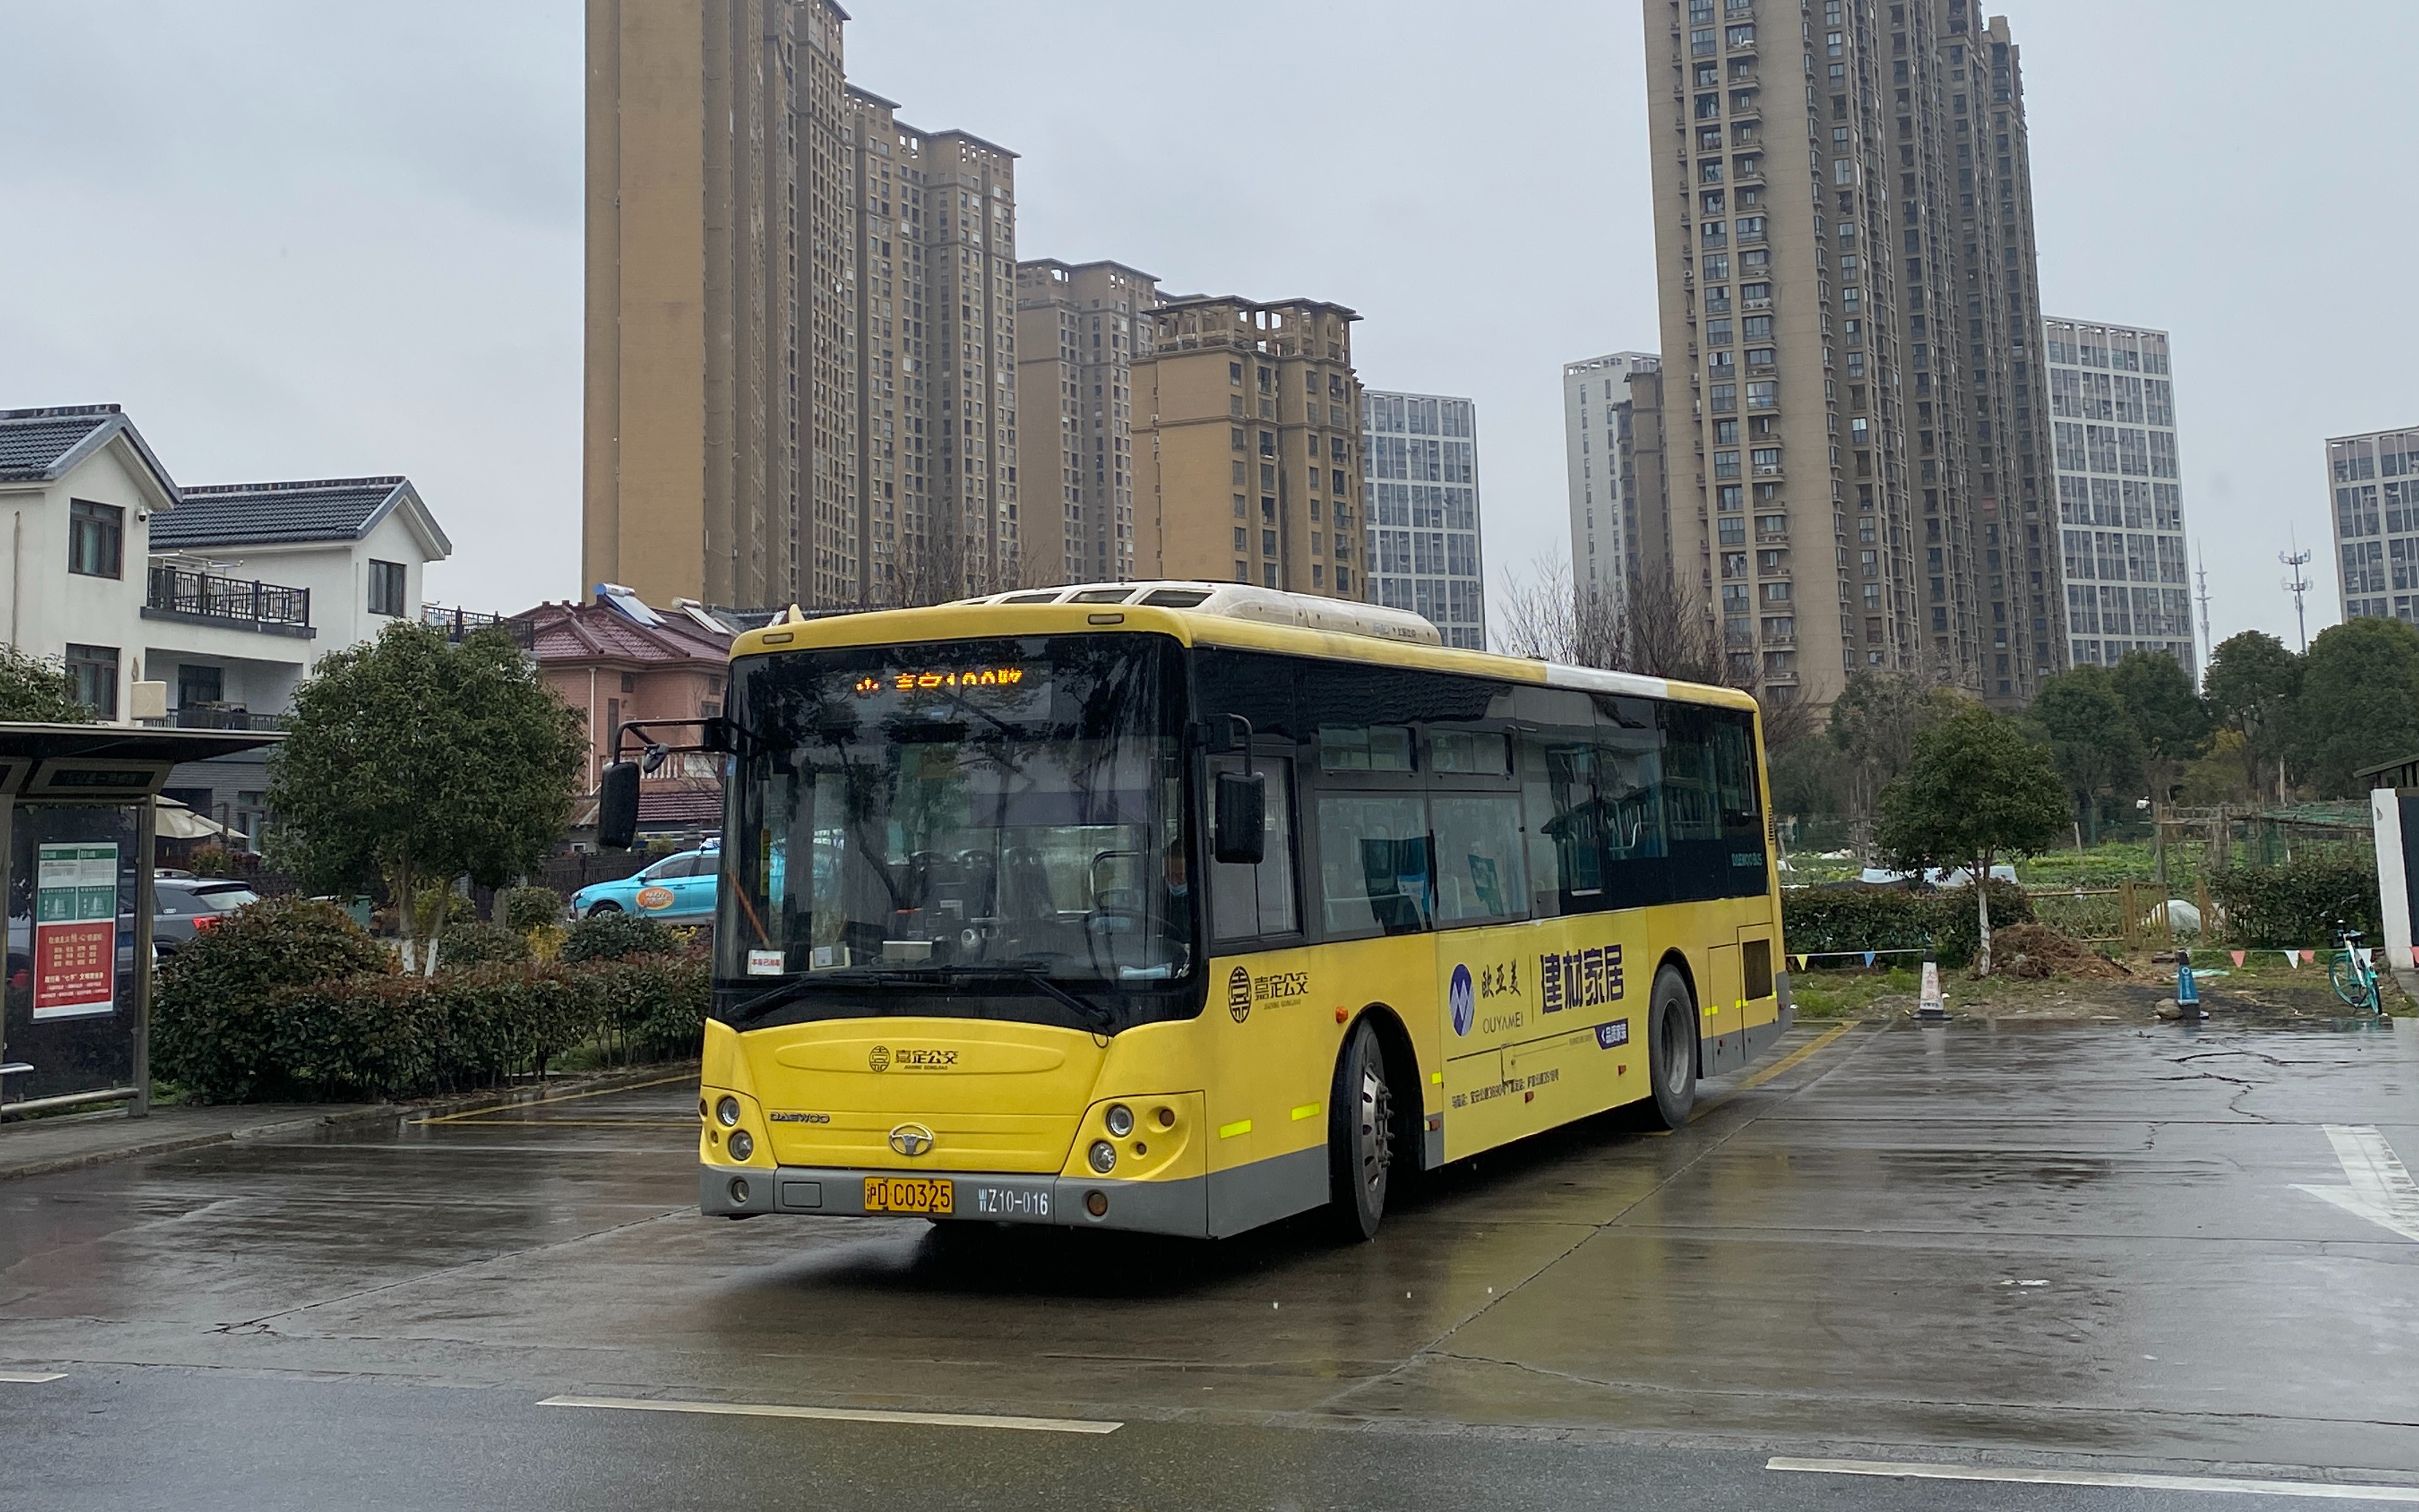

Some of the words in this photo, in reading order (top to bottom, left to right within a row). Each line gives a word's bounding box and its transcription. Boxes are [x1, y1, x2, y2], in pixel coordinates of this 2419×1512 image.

[1254, 971, 1308, 1001] 嘉定公交
[1540, 944, 1624, 1015] 建材家居
[1483, 1011, 1524, 1034] OUYAMEI
[895, 1049, 959, 1065] 嘉定公交
[770, 1112, 830, 1124] DAEWOO
